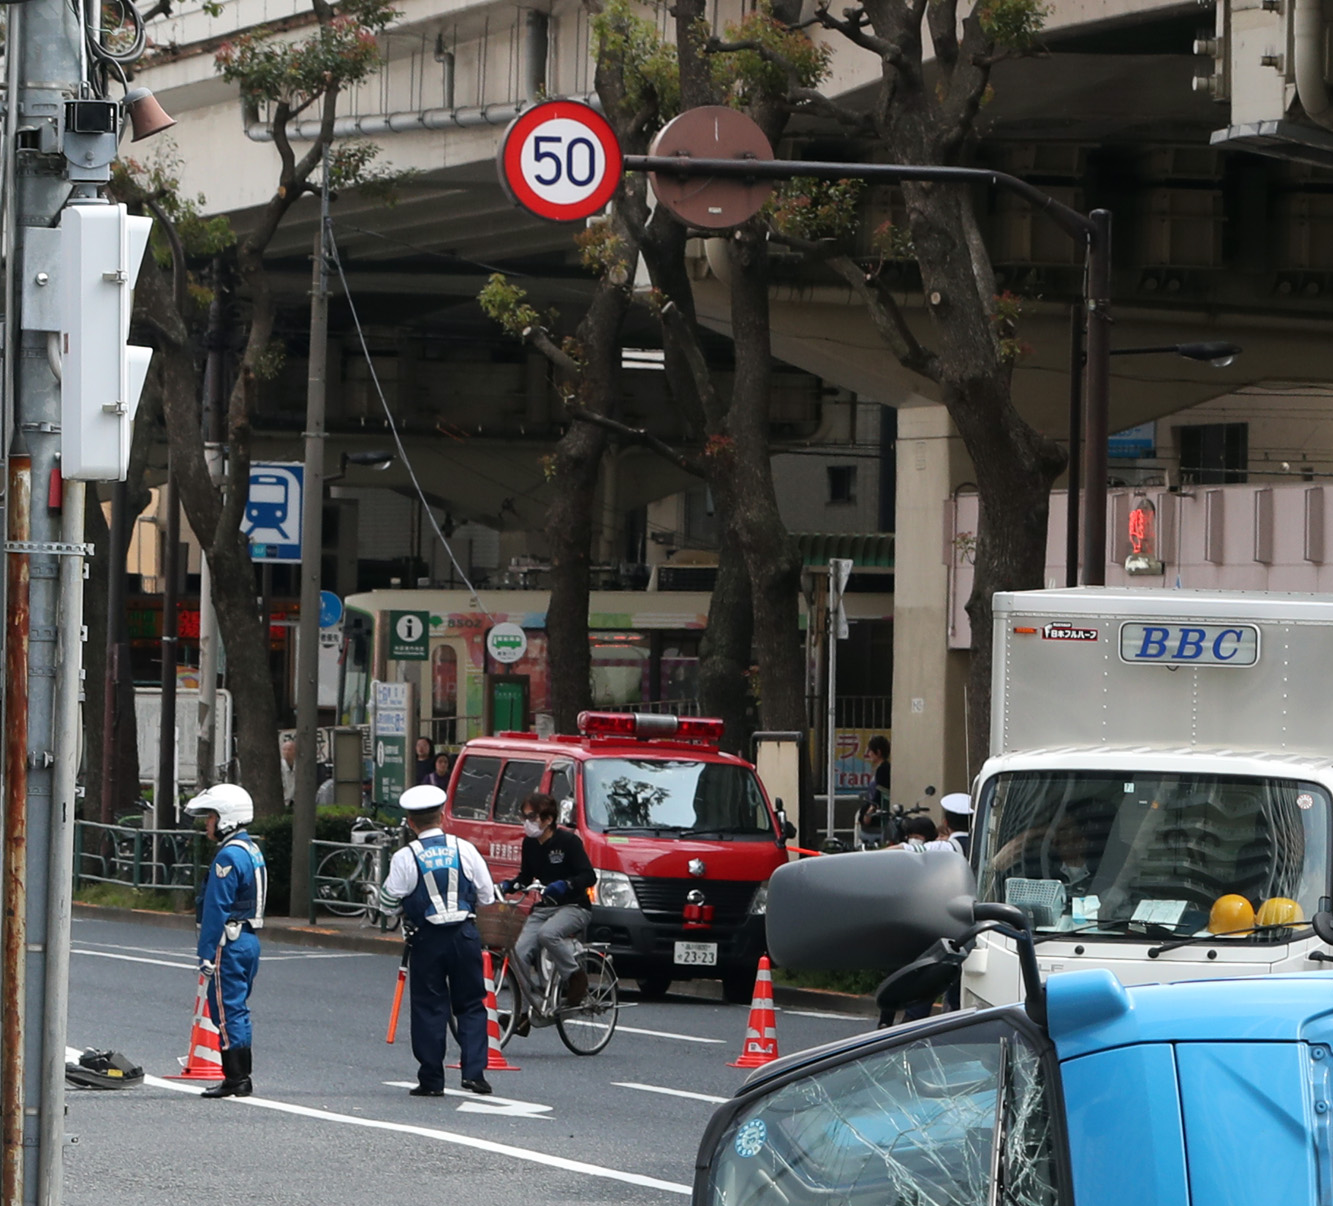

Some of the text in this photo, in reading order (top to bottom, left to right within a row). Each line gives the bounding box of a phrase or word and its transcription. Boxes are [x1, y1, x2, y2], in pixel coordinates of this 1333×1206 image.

[534, 135, 595, 187] 50
[1135, 626, 1243, 660] BBC
[419, 846, 456, 863] POLICE
